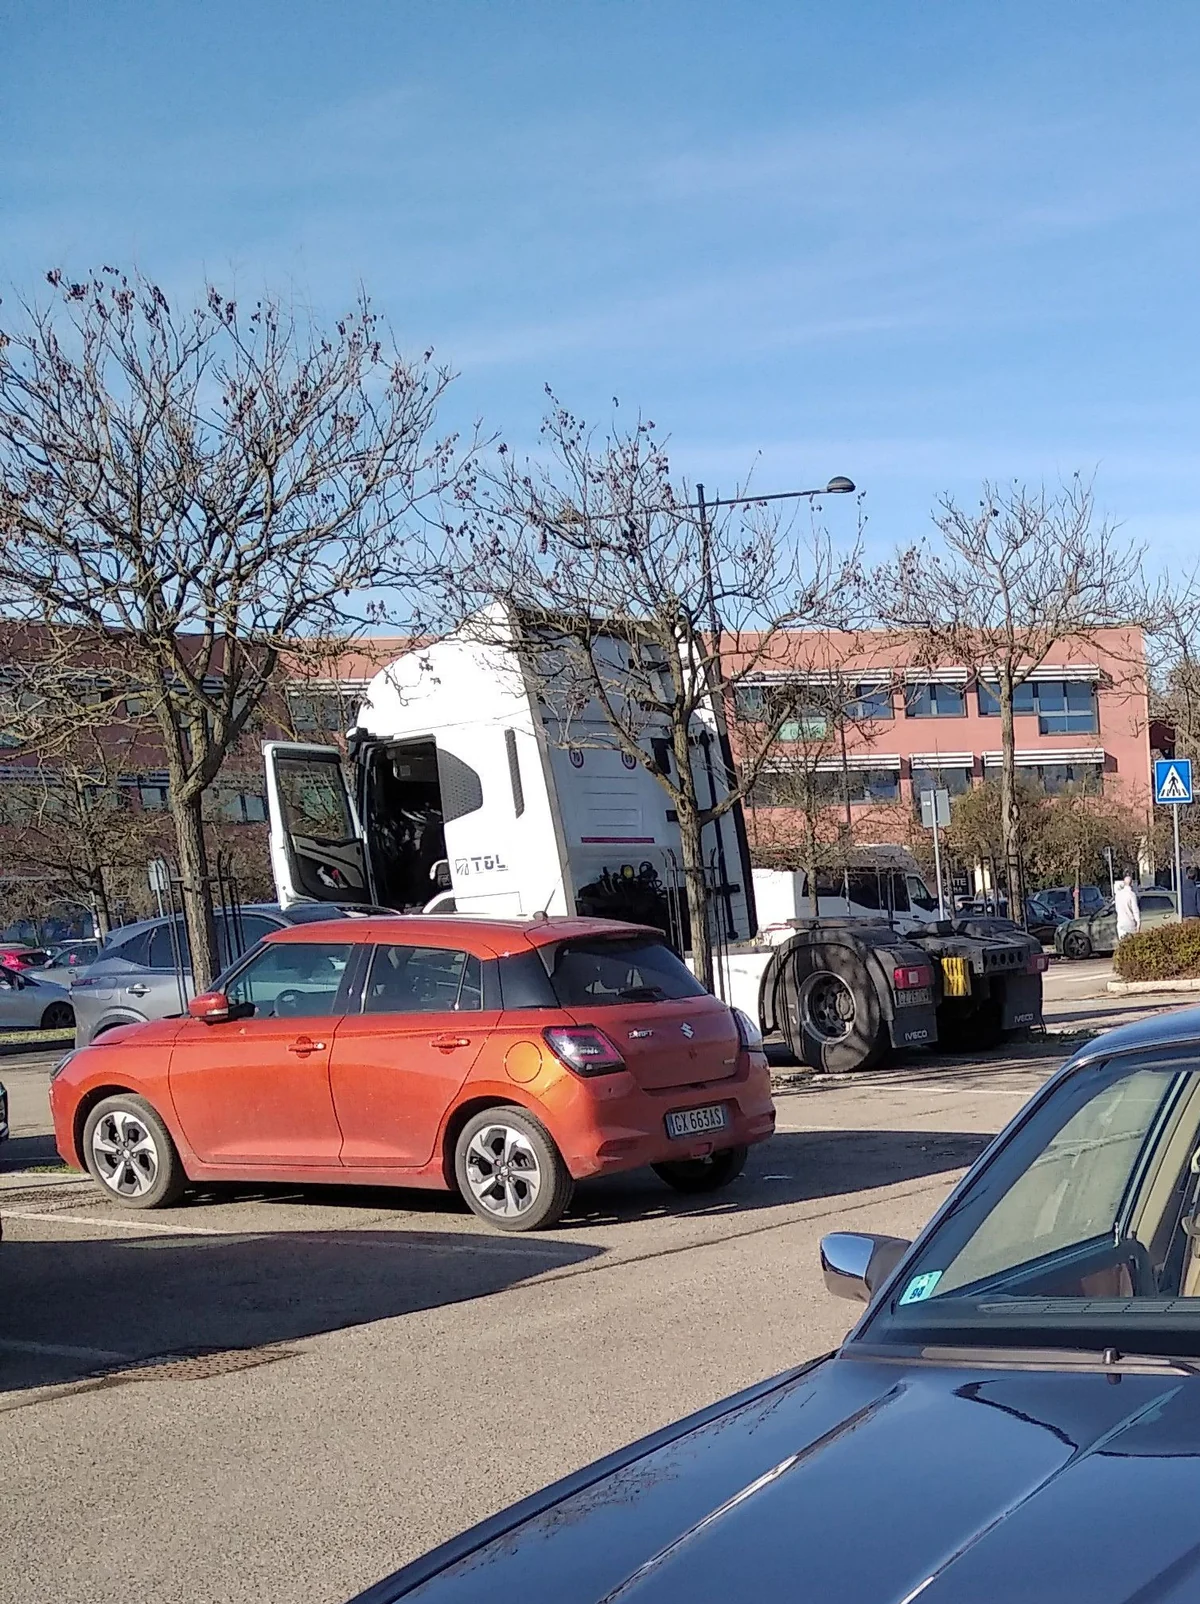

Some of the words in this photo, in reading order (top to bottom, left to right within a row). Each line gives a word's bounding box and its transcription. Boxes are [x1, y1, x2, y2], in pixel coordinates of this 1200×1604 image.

[904, 1030, 928, 1041] IVECO
[674, 1114, 689, 1132] GX
[690, 1108, 722, 1130] 663AS
